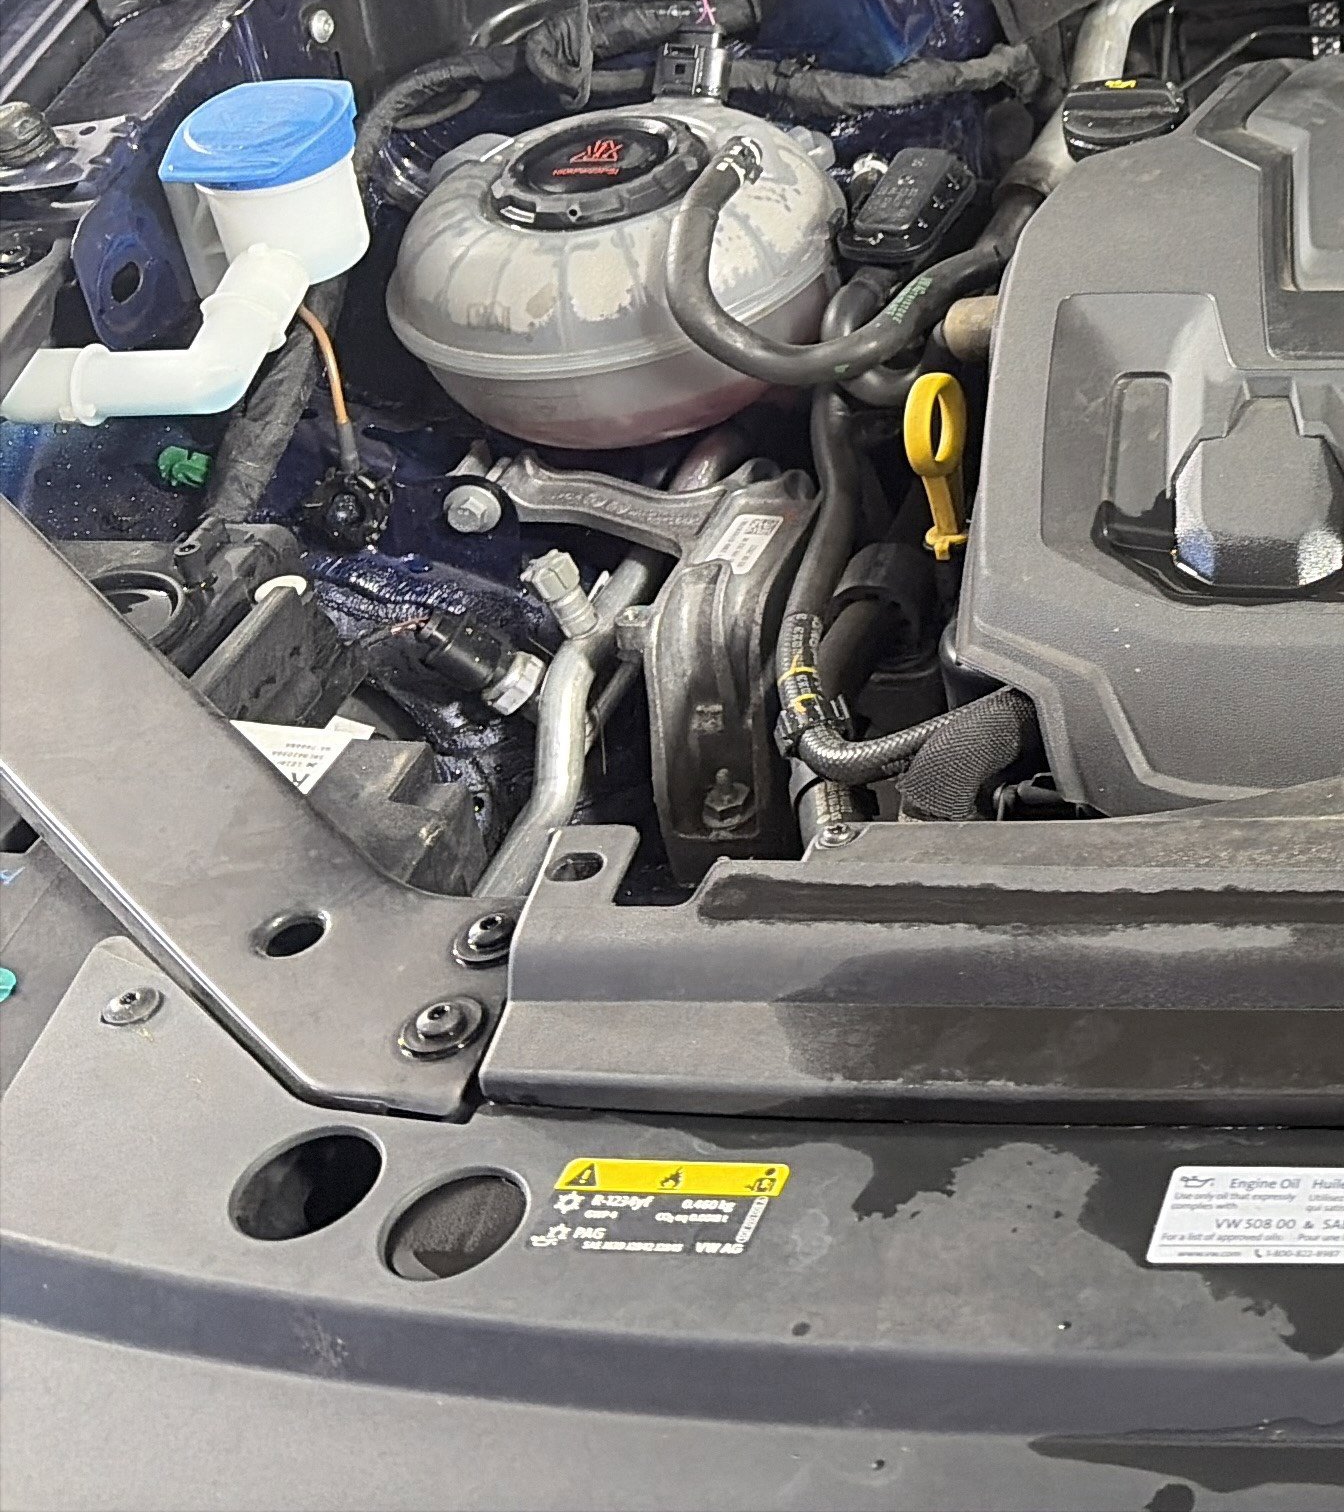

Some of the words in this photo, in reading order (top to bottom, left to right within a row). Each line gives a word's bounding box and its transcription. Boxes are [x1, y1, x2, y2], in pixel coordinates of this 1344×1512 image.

[1229, 1178, 1276, 1191] Engine
[1280, 1178, 1301, 1189] Oil
[591, 1194, 655, 1210] R-1234yf
[1215, 1219, 1242, 1230] VW
[1245, 1218, 1272, 1230] 508
[1276, 1218, 1297, 1230] 00
[1303, 1221, 1314, 1230] &
[572, 1226, 607, 1239] PAG
[695, 1242, 722, 1254] VW
[719, 1242, 744, 1254] AG
